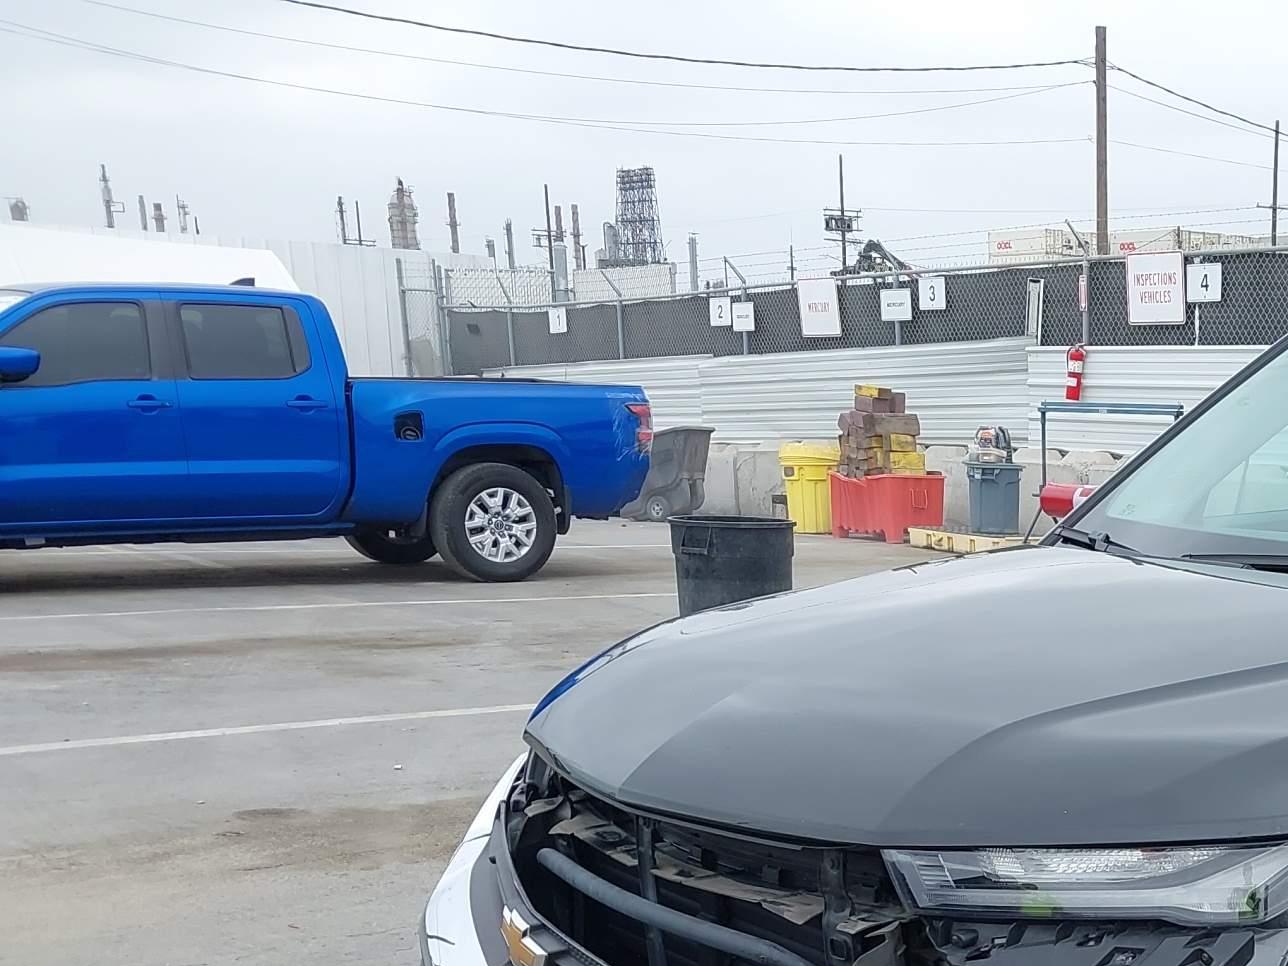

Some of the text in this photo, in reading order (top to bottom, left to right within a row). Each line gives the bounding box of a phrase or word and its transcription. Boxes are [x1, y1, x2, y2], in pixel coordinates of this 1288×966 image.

[1133, 271, 1177, 287] INSPECTIONS
[1200, 273, 1210, 292] 4
[928, 285, 936, 302] 3
[1140, 290, 1172, 304] VEHICLES
[717, 304, 724, 319] 2
[807, 302, 831, 313] MERCURY
